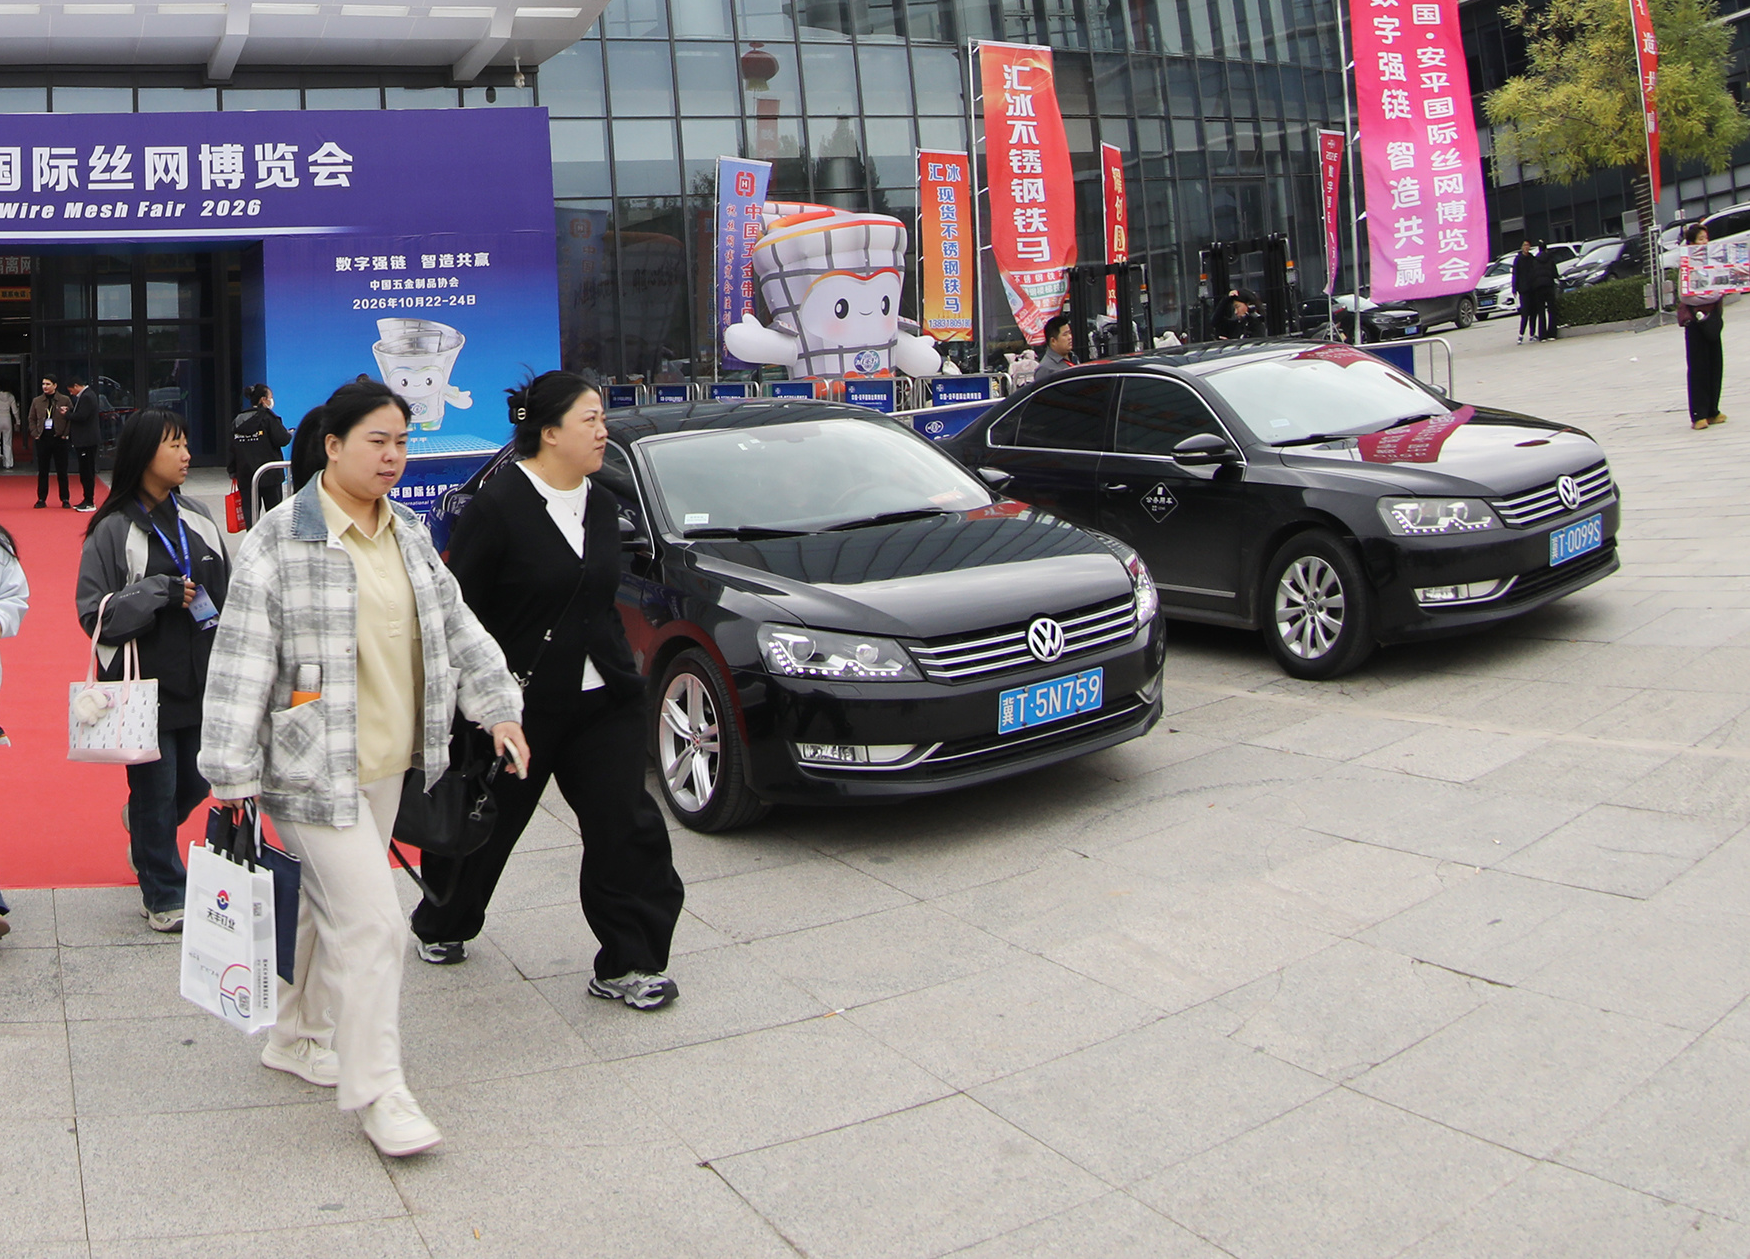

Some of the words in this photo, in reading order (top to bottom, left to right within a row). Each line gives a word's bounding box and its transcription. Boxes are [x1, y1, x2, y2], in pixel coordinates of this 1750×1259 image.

[928, 163, 962, 183] 汇冰
[1002, 64, 1052, 263] 汇冰不锈钢铁马
[64, 201, 129, 219] Mesh
[138, 200, 186, 218] Fair
[200, 200, 262, 217] 2026
[1386, 141, 1426, 288] 智造共赢
[937, 187, 962, 313] 现货不锈钢铁马
[335, 254, 407, 272] 数字强链
[420, 252, 490, 269] 智造共赢
[369, 277, 460, 292] 中国五金制品协会
[353, 294, 477, 310] 2026年10月22-24日
